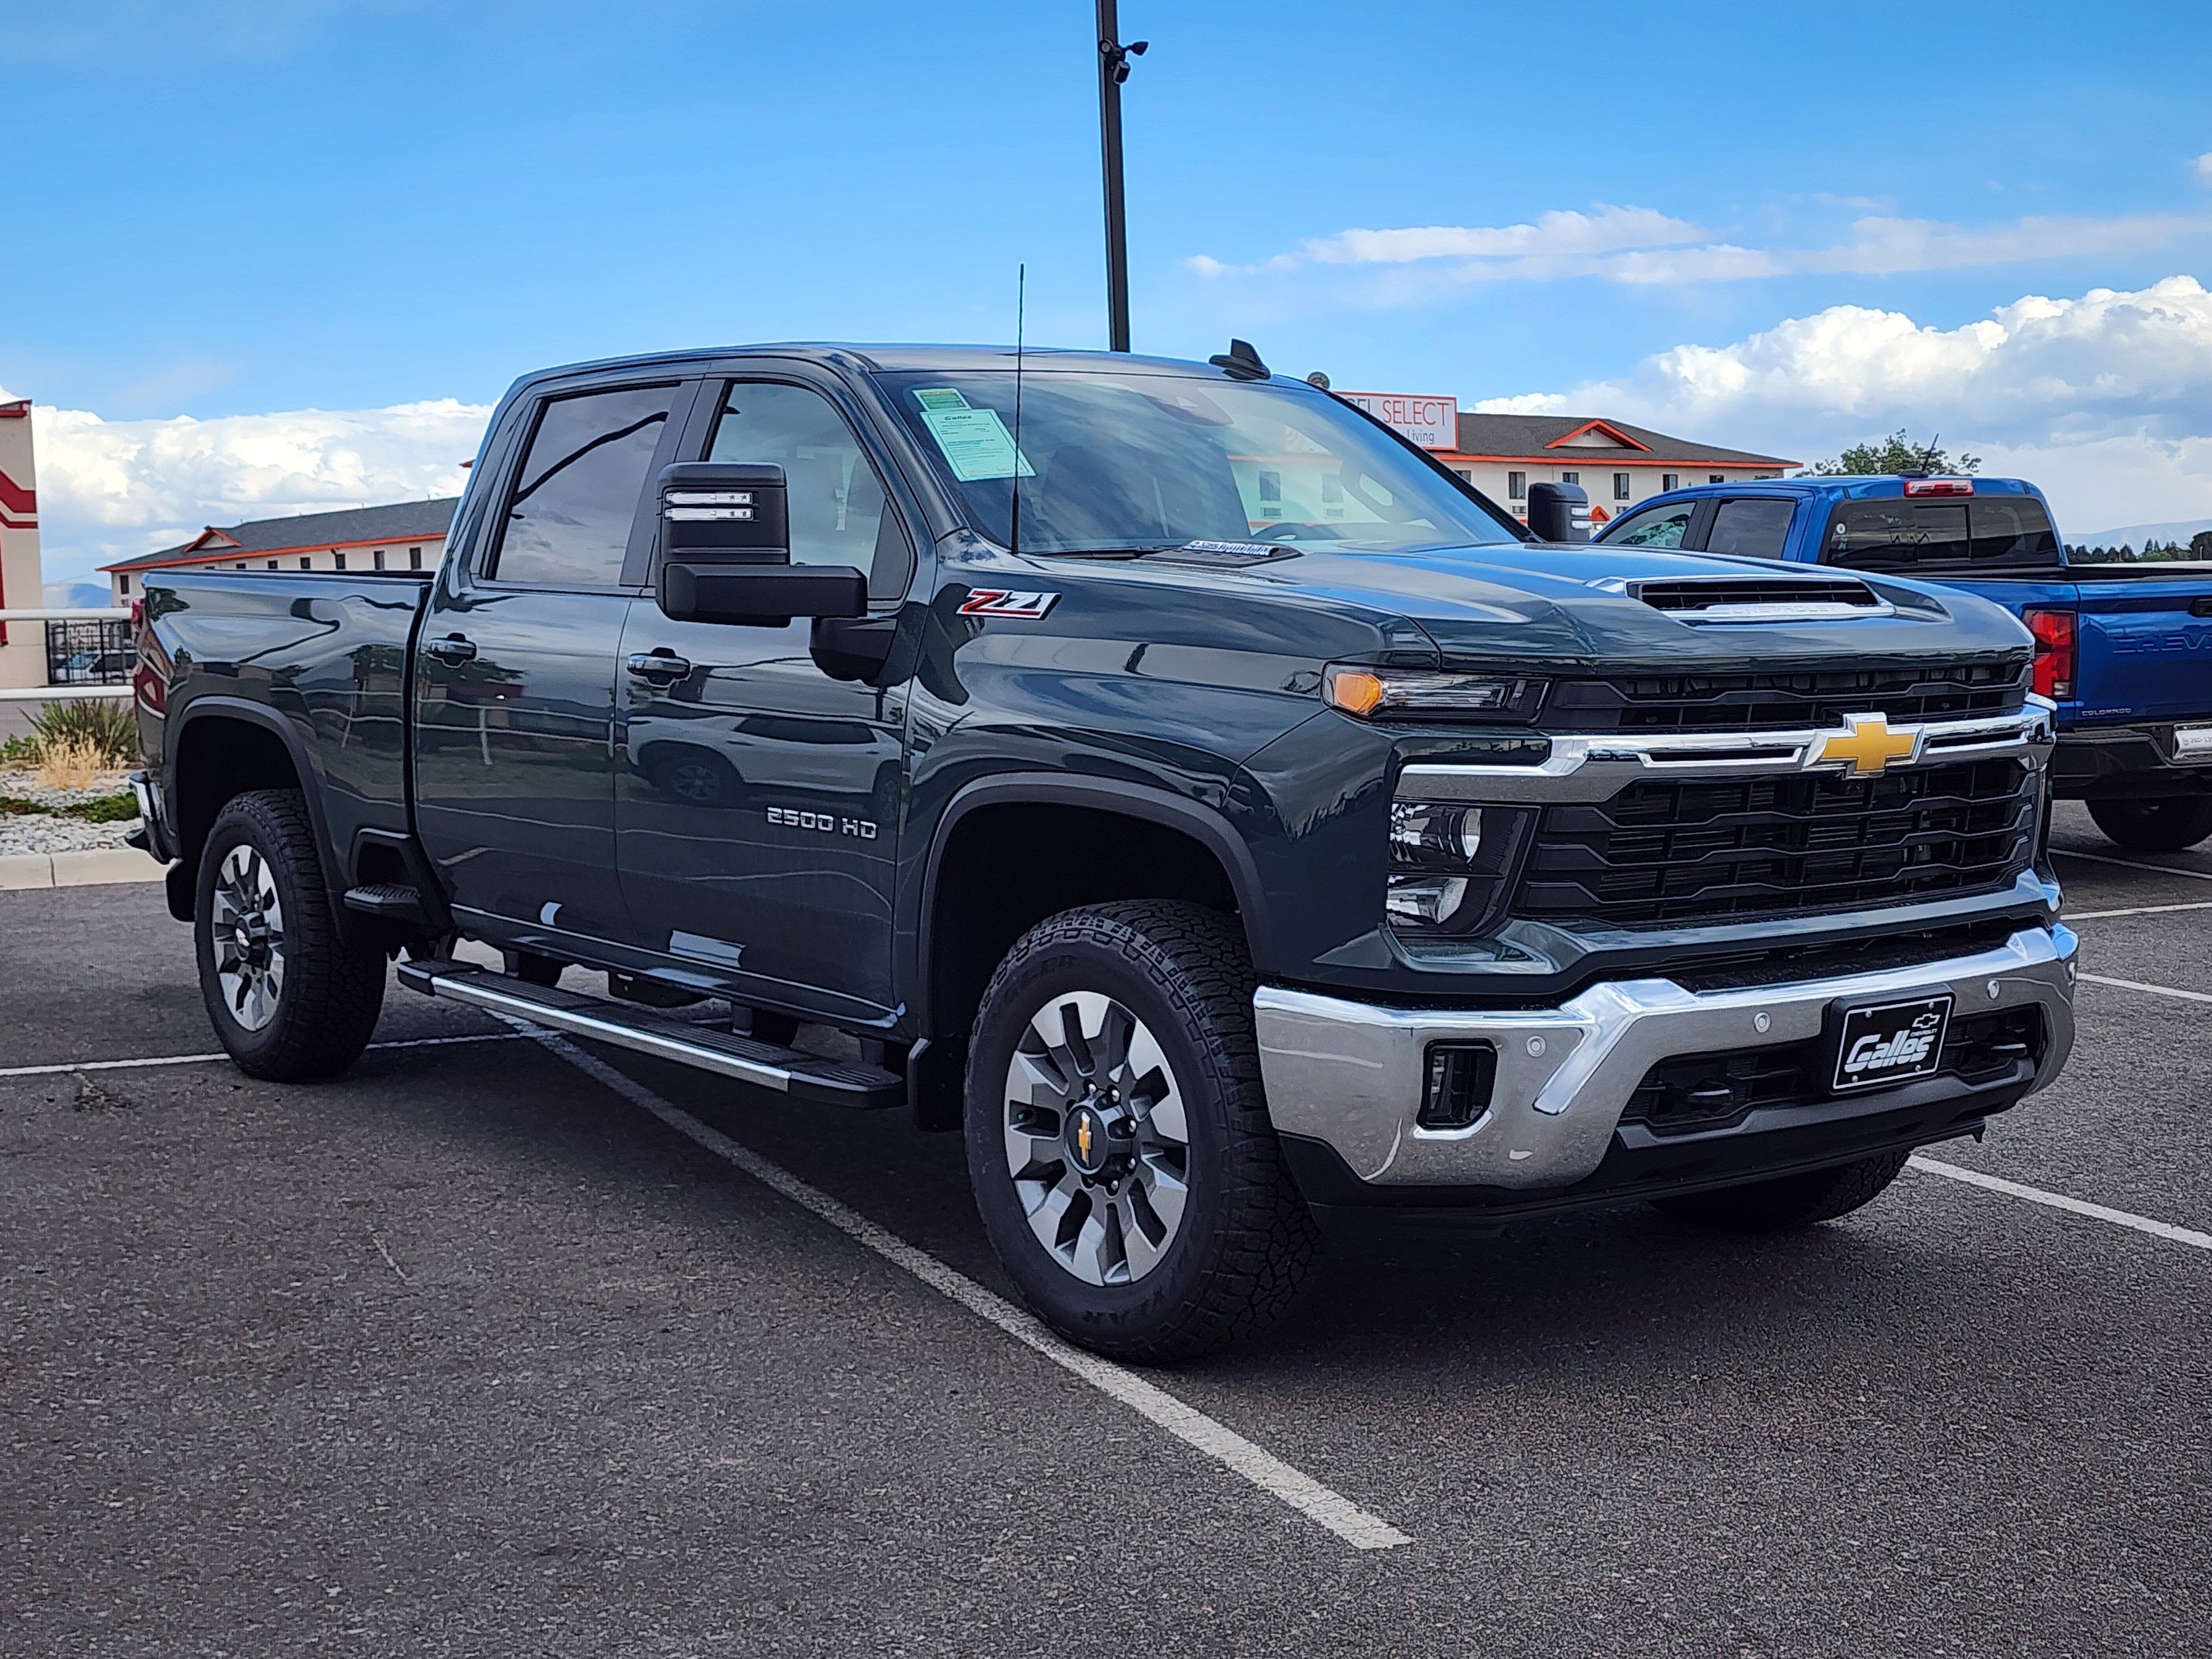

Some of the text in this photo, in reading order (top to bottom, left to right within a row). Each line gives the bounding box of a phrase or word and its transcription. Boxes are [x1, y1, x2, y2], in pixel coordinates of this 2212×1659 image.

[1383, 400, 1449, 426] SELECT
[956, 587, 1062, 620] Z71
[2081, 708, 2132, 716] COLORADO
[766, 806, 878, 839] 2500 HD
[1844, 1029, 1936, 1073] Galles
